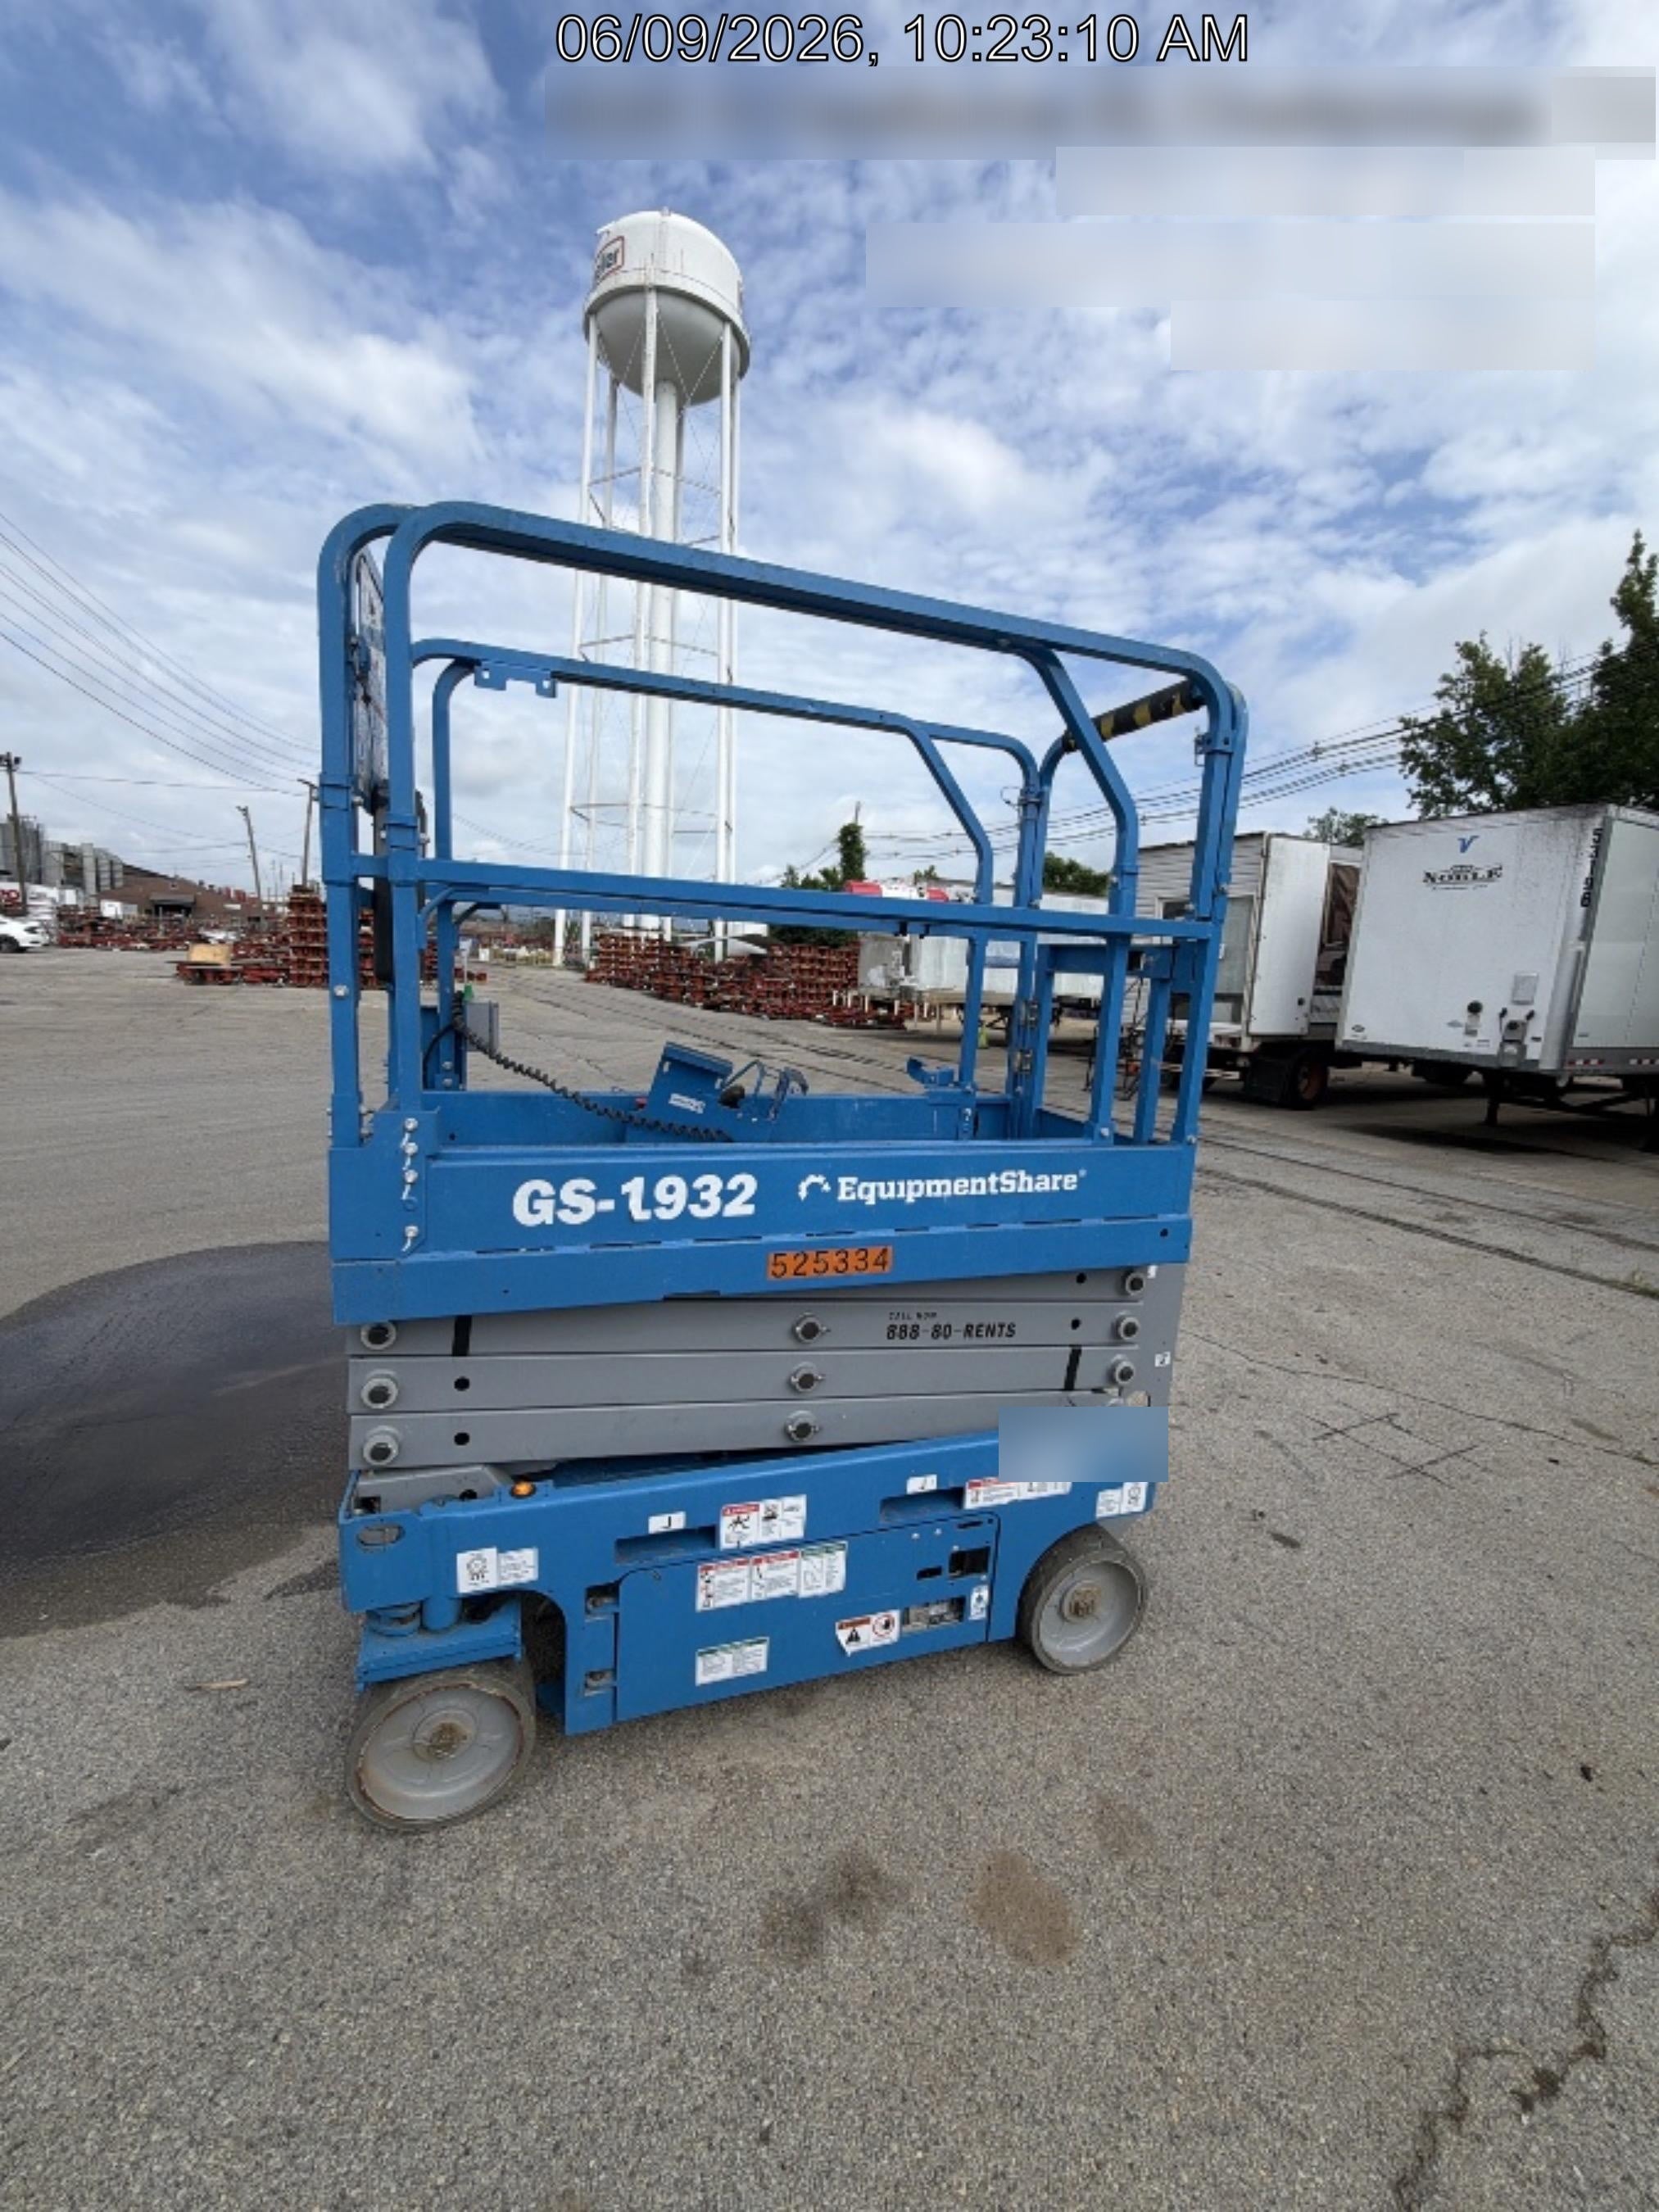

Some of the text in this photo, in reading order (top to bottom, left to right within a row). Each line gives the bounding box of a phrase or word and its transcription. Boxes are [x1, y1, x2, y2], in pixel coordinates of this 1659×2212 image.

[513, 1173, 758, 1227] GS-1932
[837, 1169, 1079, 1205] EquipmentShare
[771, 1247, 889, 1279] 525334
